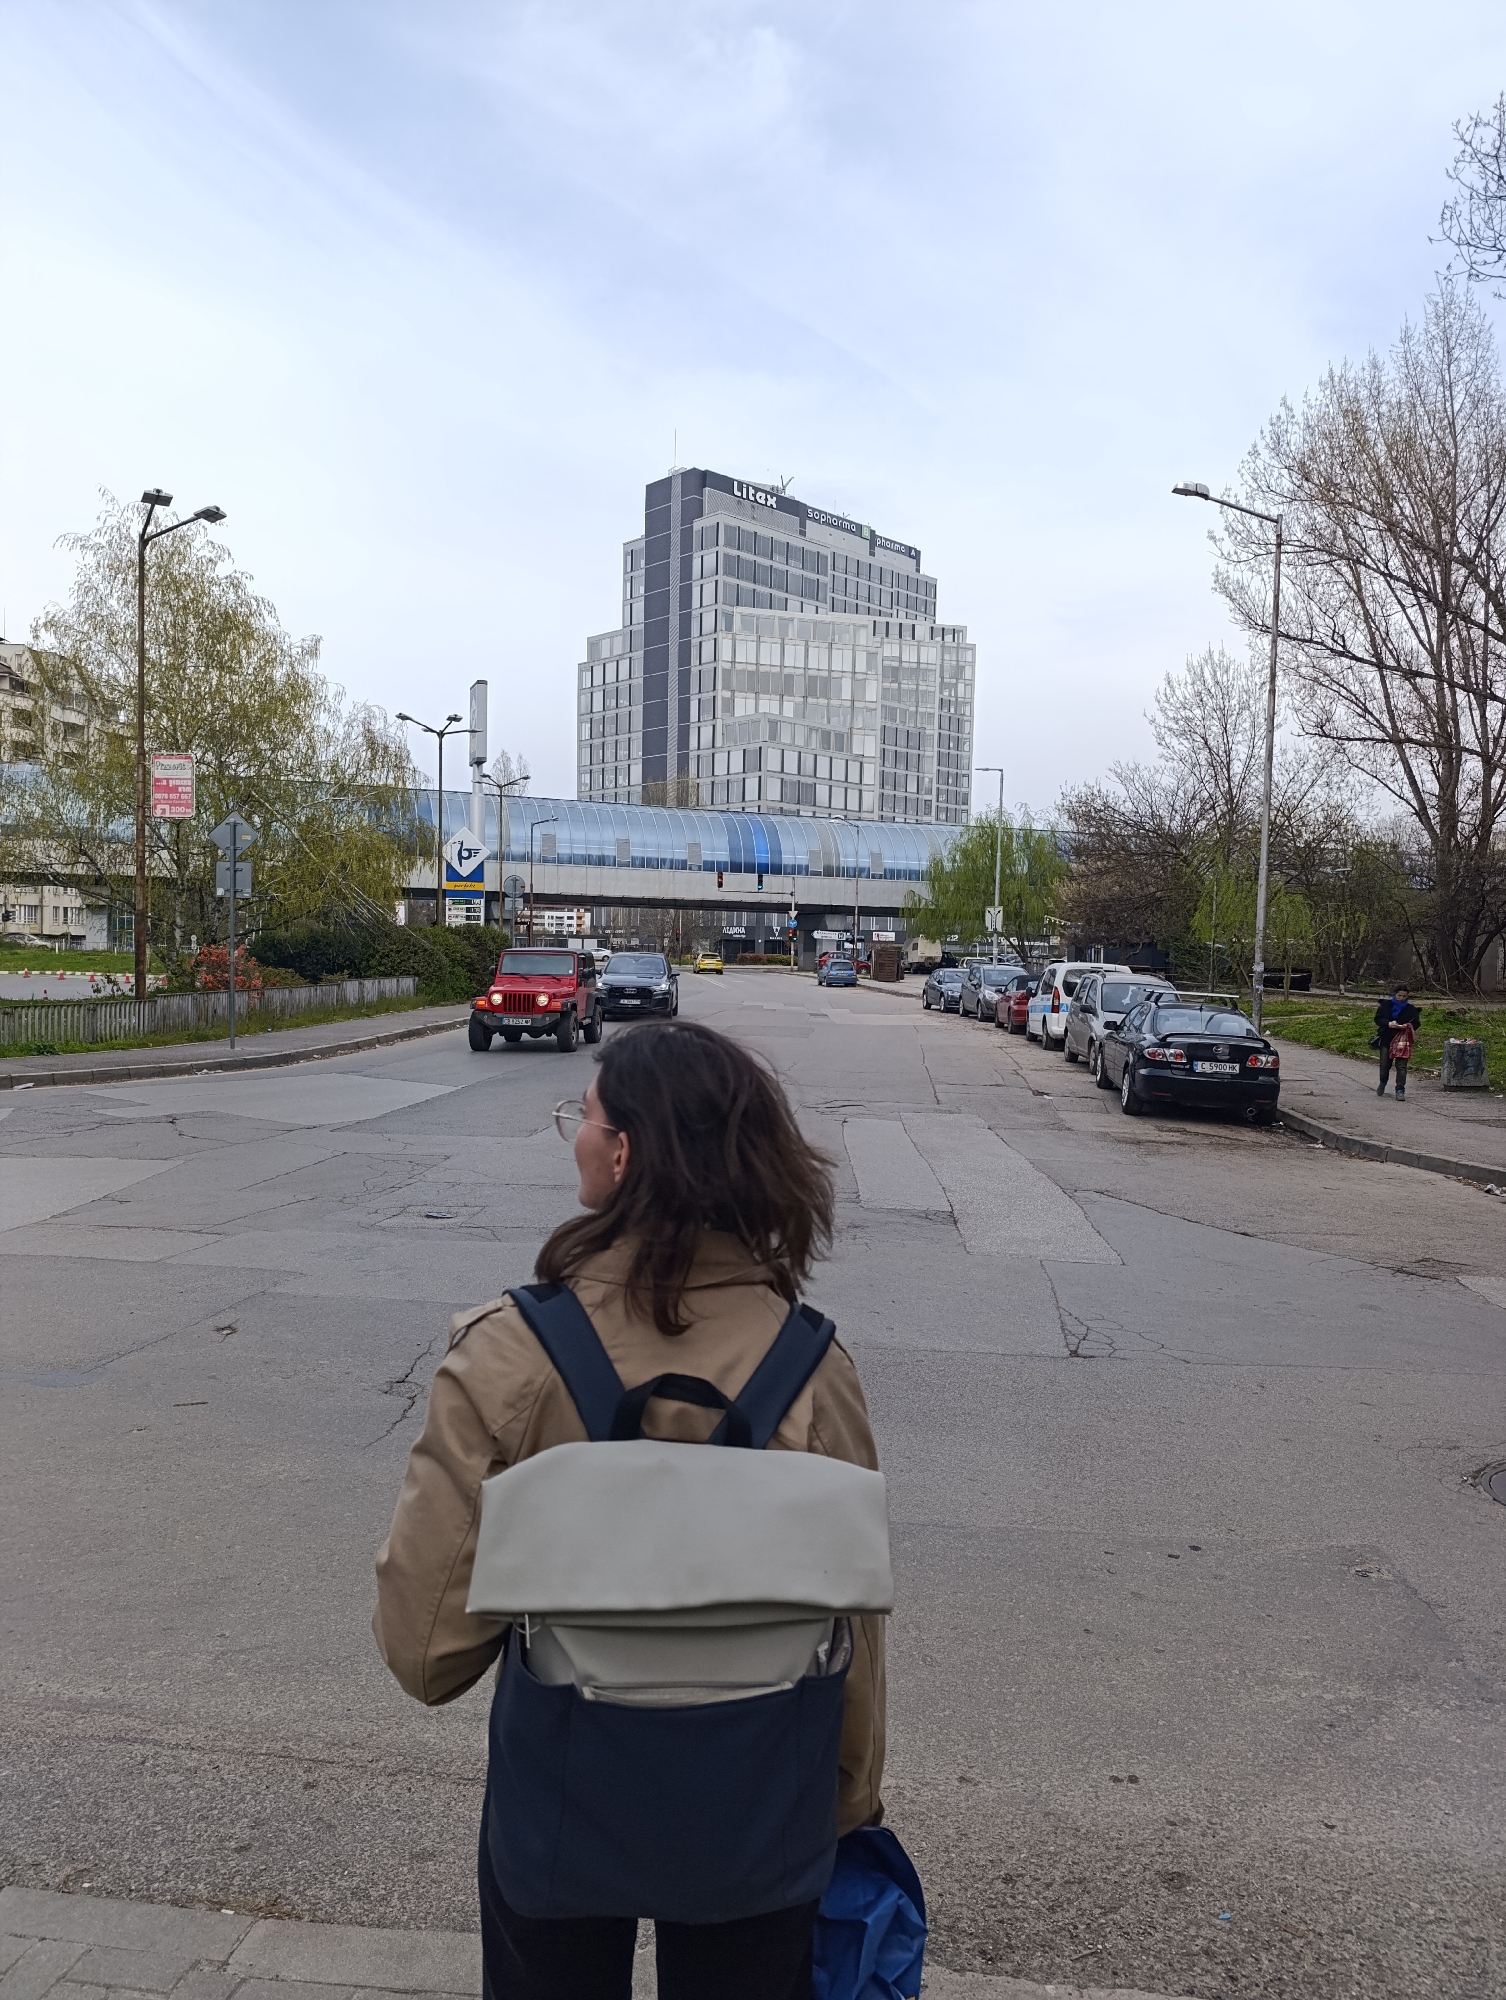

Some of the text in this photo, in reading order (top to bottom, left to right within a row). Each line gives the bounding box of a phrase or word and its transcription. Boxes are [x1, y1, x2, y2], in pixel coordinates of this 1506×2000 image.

[807, 508, 856, 532] sopharma
[1209, 1062, 1227, 1071] 5900
[1228, 1064, 1238, 1072] HK
